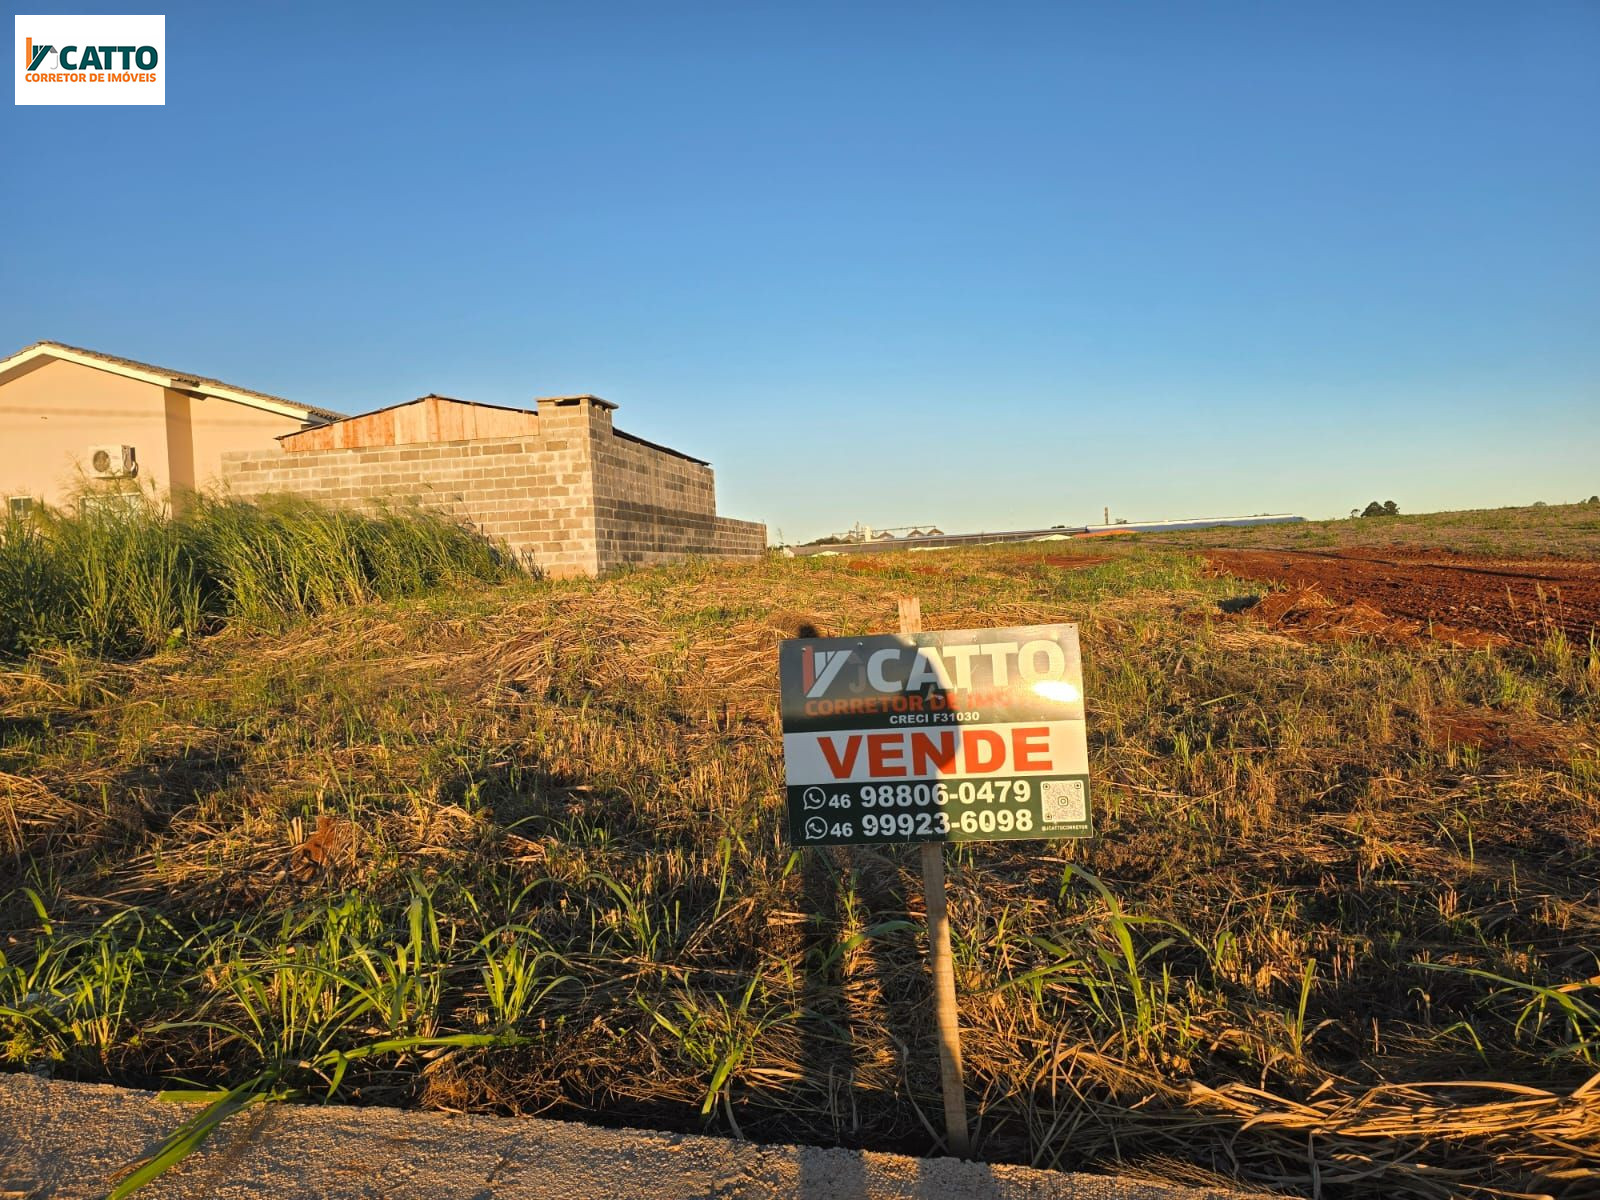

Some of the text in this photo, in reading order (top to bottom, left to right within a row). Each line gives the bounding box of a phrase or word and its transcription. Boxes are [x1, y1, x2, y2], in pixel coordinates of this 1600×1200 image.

[866, 639, 1066, 693] CATTO
[805, 694, 924, 717] CORRETOR
[931, 693, 961, 713] DE
[889, 712, 980, 725] CRECI F31030
[817, 727, 1053, 779] VENDE
[828, 780, 1031, 809] 46 98806-0479
[830, 809, 1033, 838] 46 99923-6098
